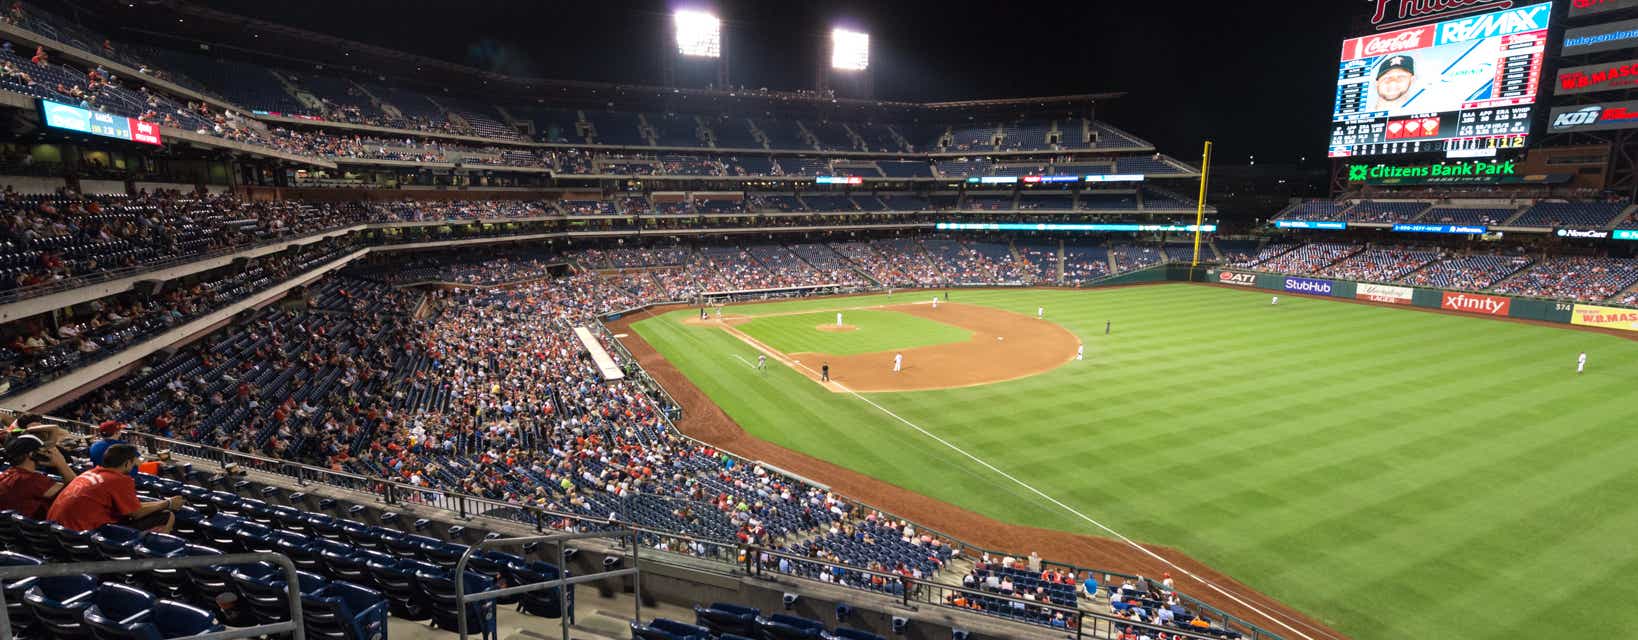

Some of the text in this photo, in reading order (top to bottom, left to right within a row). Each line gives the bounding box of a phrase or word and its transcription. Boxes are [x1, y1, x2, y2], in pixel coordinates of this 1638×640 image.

[1441, 8, 1540, 44] RE/MAX
[1512, 137, 1523, 148] 2
[1370, 160, 1514, 177] Citizens Bank Park
[1231, 273, 1256, 282] ATI
[1286, 279, 1330, 293] StubHub
[1446, 295, 1504, 313] xfinity
